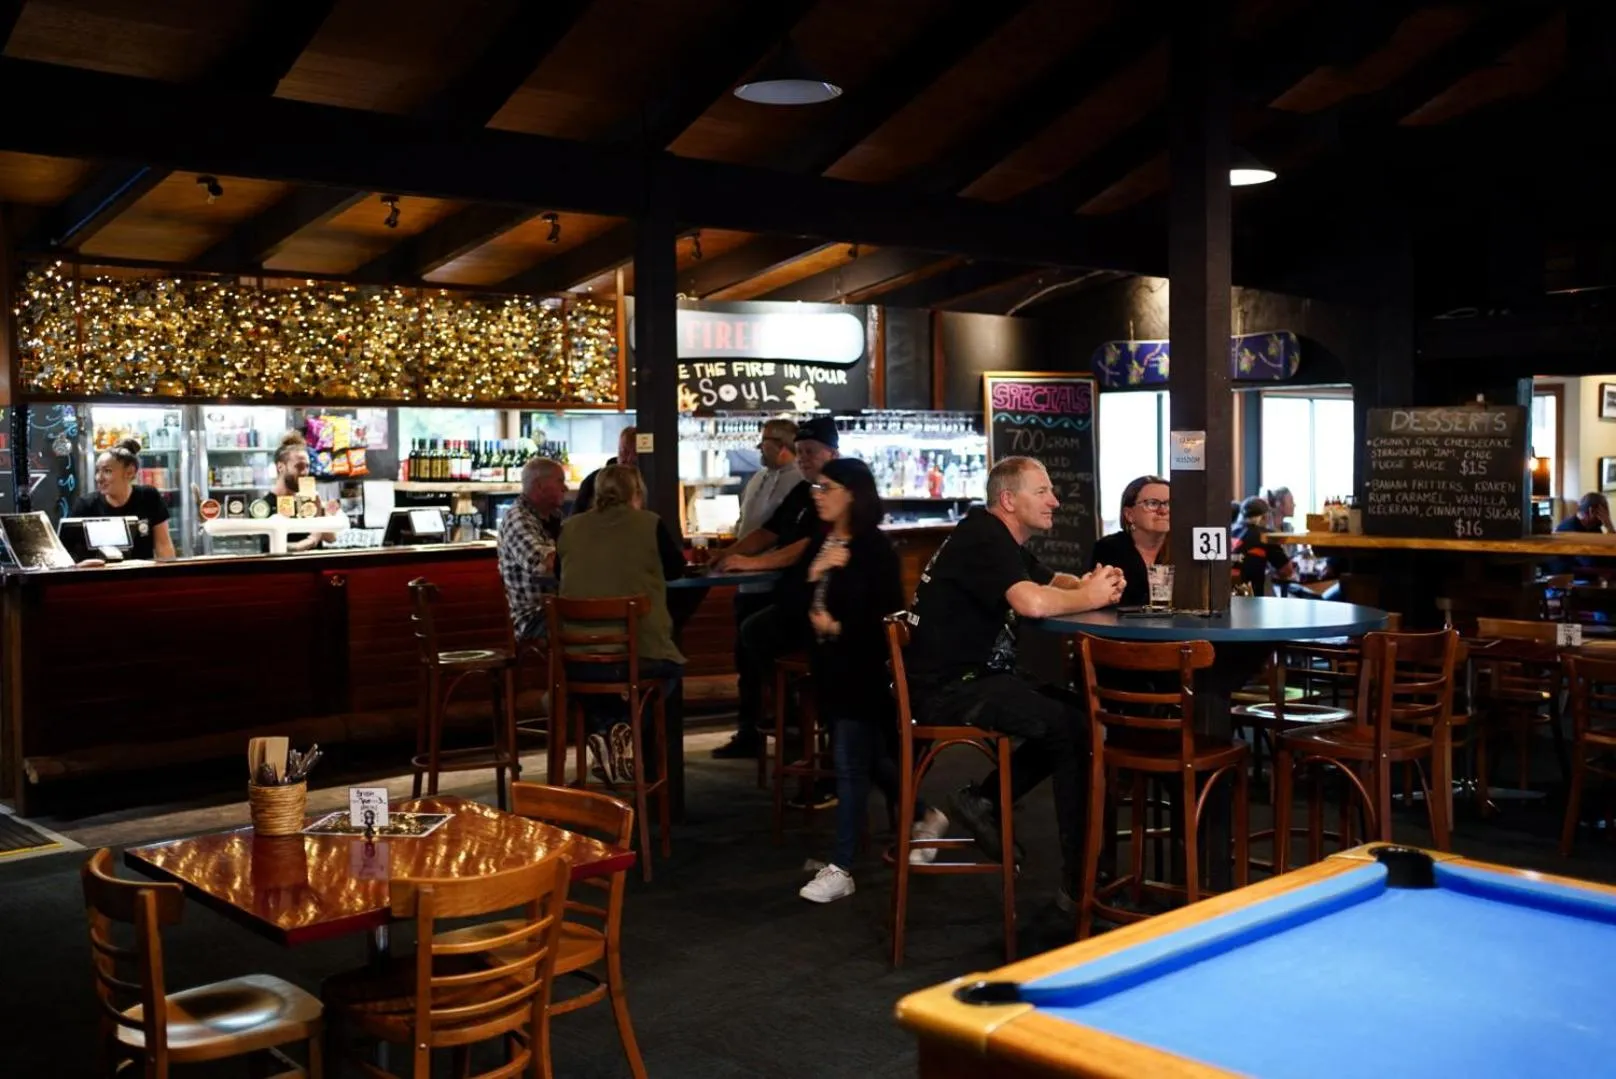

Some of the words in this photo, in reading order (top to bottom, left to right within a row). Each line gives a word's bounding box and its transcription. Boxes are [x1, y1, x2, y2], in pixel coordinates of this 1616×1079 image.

[693, 362, 726, 378] THE
[732, 361, 776, 377] FIRE
[784, 364, 801, 378] IN
[805, 366, 848, 385] YOUR
[699, 378, 780, 406] SOUL
[992, 383, 1092, 413] SPECIALS
[1390, 410, 1508, 433] DESSERTS
[1005, 428, 1046, 451] 700
[1413, 460, 1446, 471] SAUCE
[1459, 460, 1488, 476] $15
[1484, 507, 1521, 521] SUGAR
[1454, 518, 1483, 538] $16
[1200, 533, 1220, 554] 31
